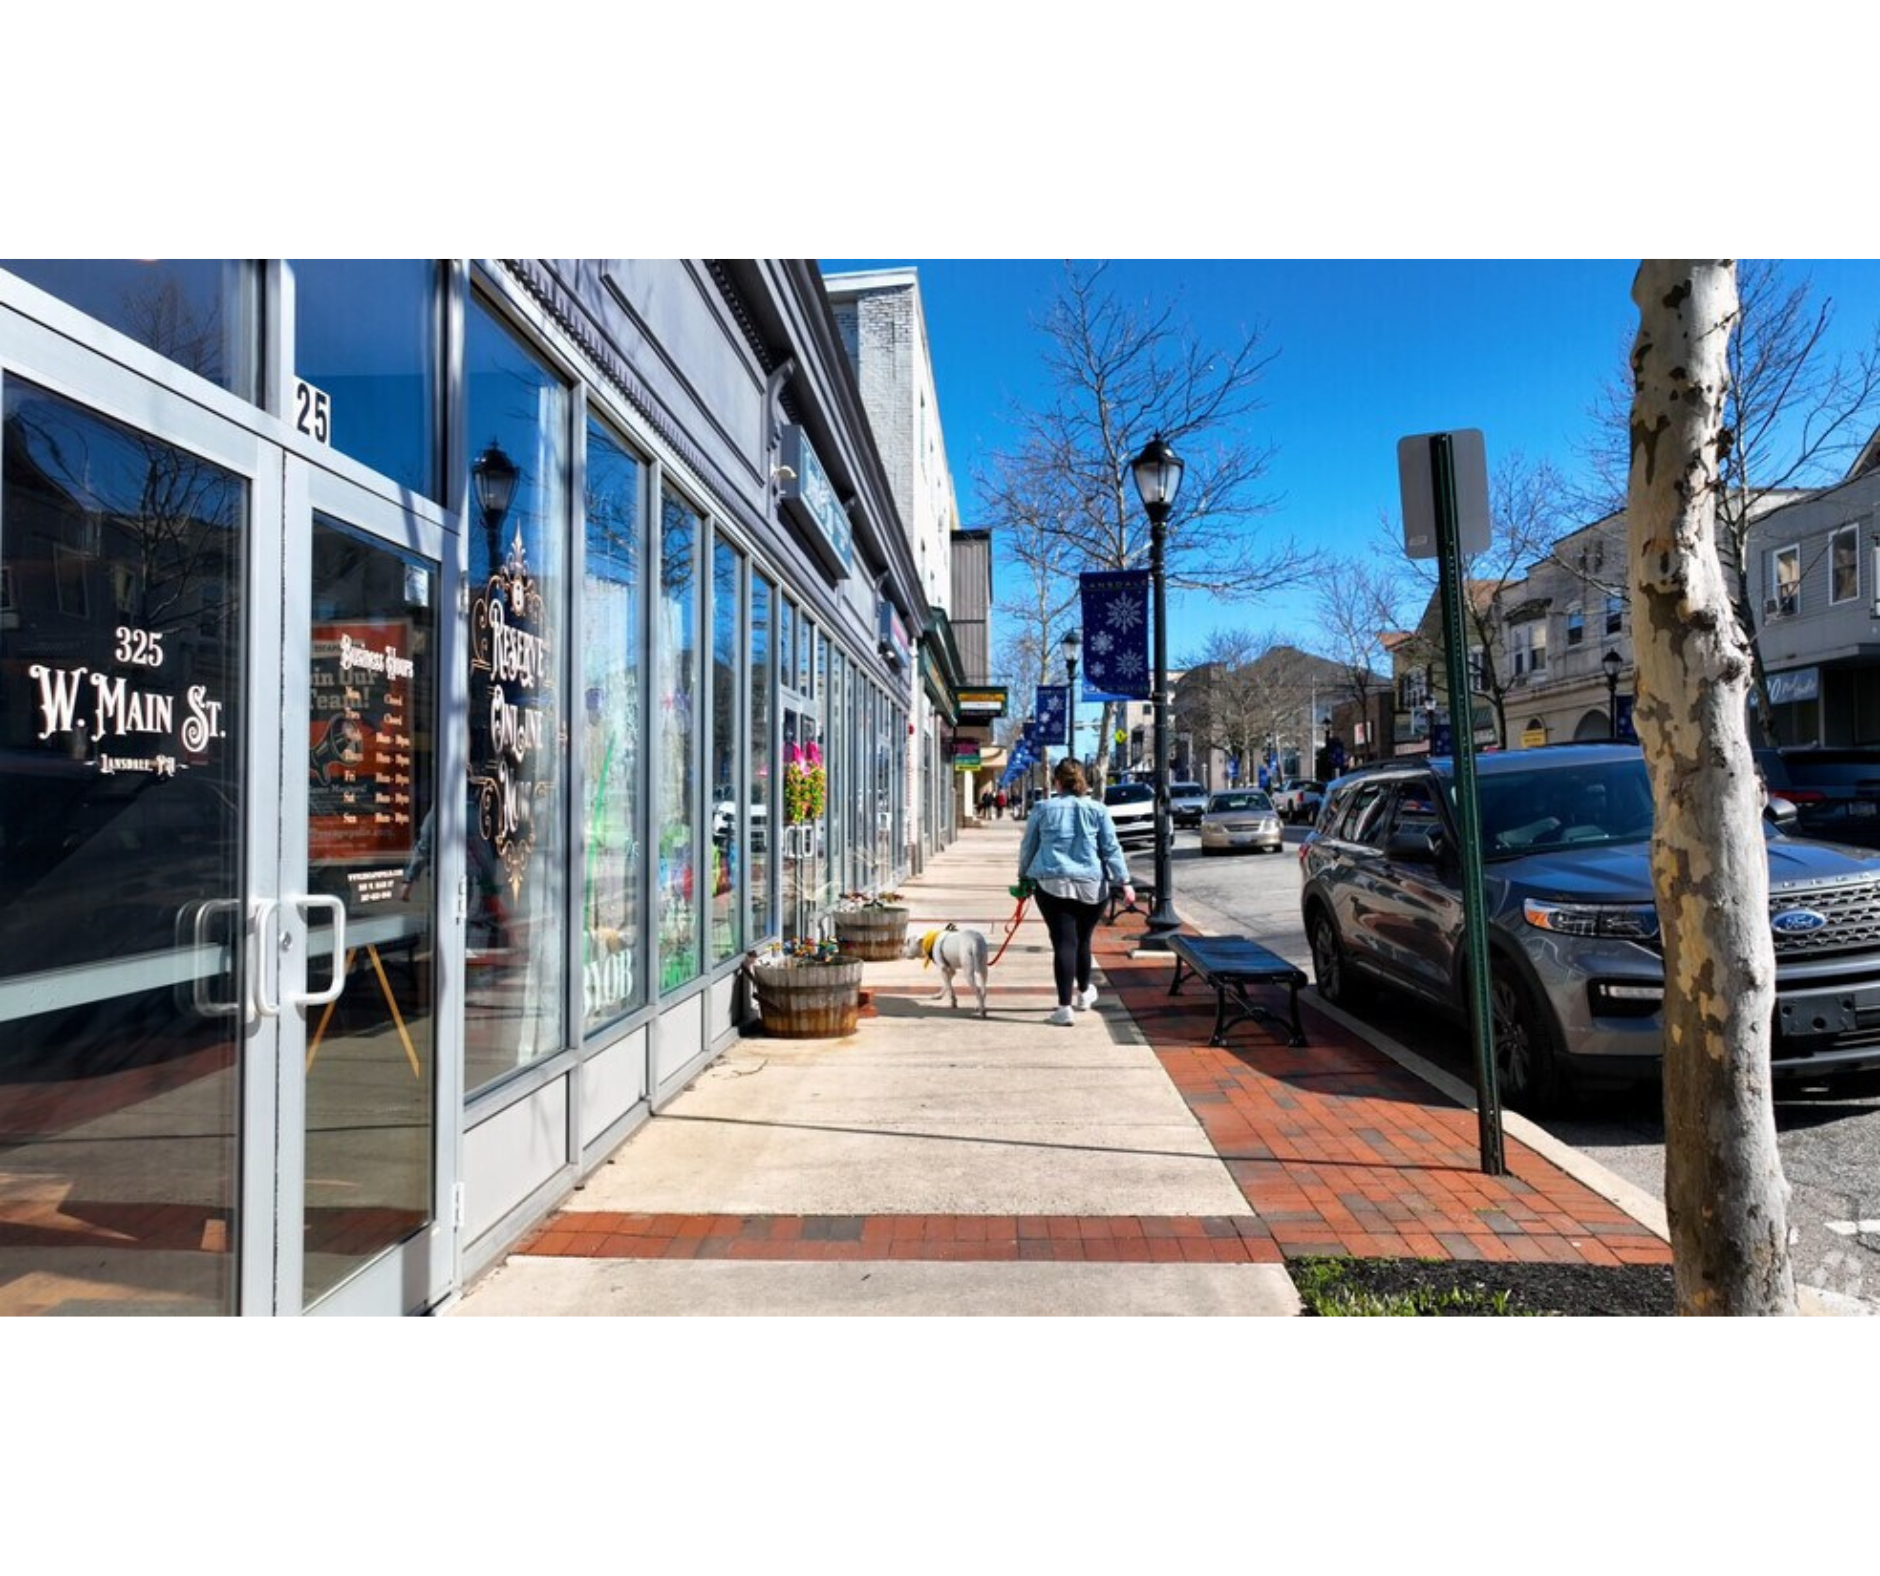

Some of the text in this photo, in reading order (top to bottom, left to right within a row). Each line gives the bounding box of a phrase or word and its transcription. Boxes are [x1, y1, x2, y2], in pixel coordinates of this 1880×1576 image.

[298, 382, 328, 443] 25
[115, 626, 164, 667] 325
[29, 664, 86, 740] W.
